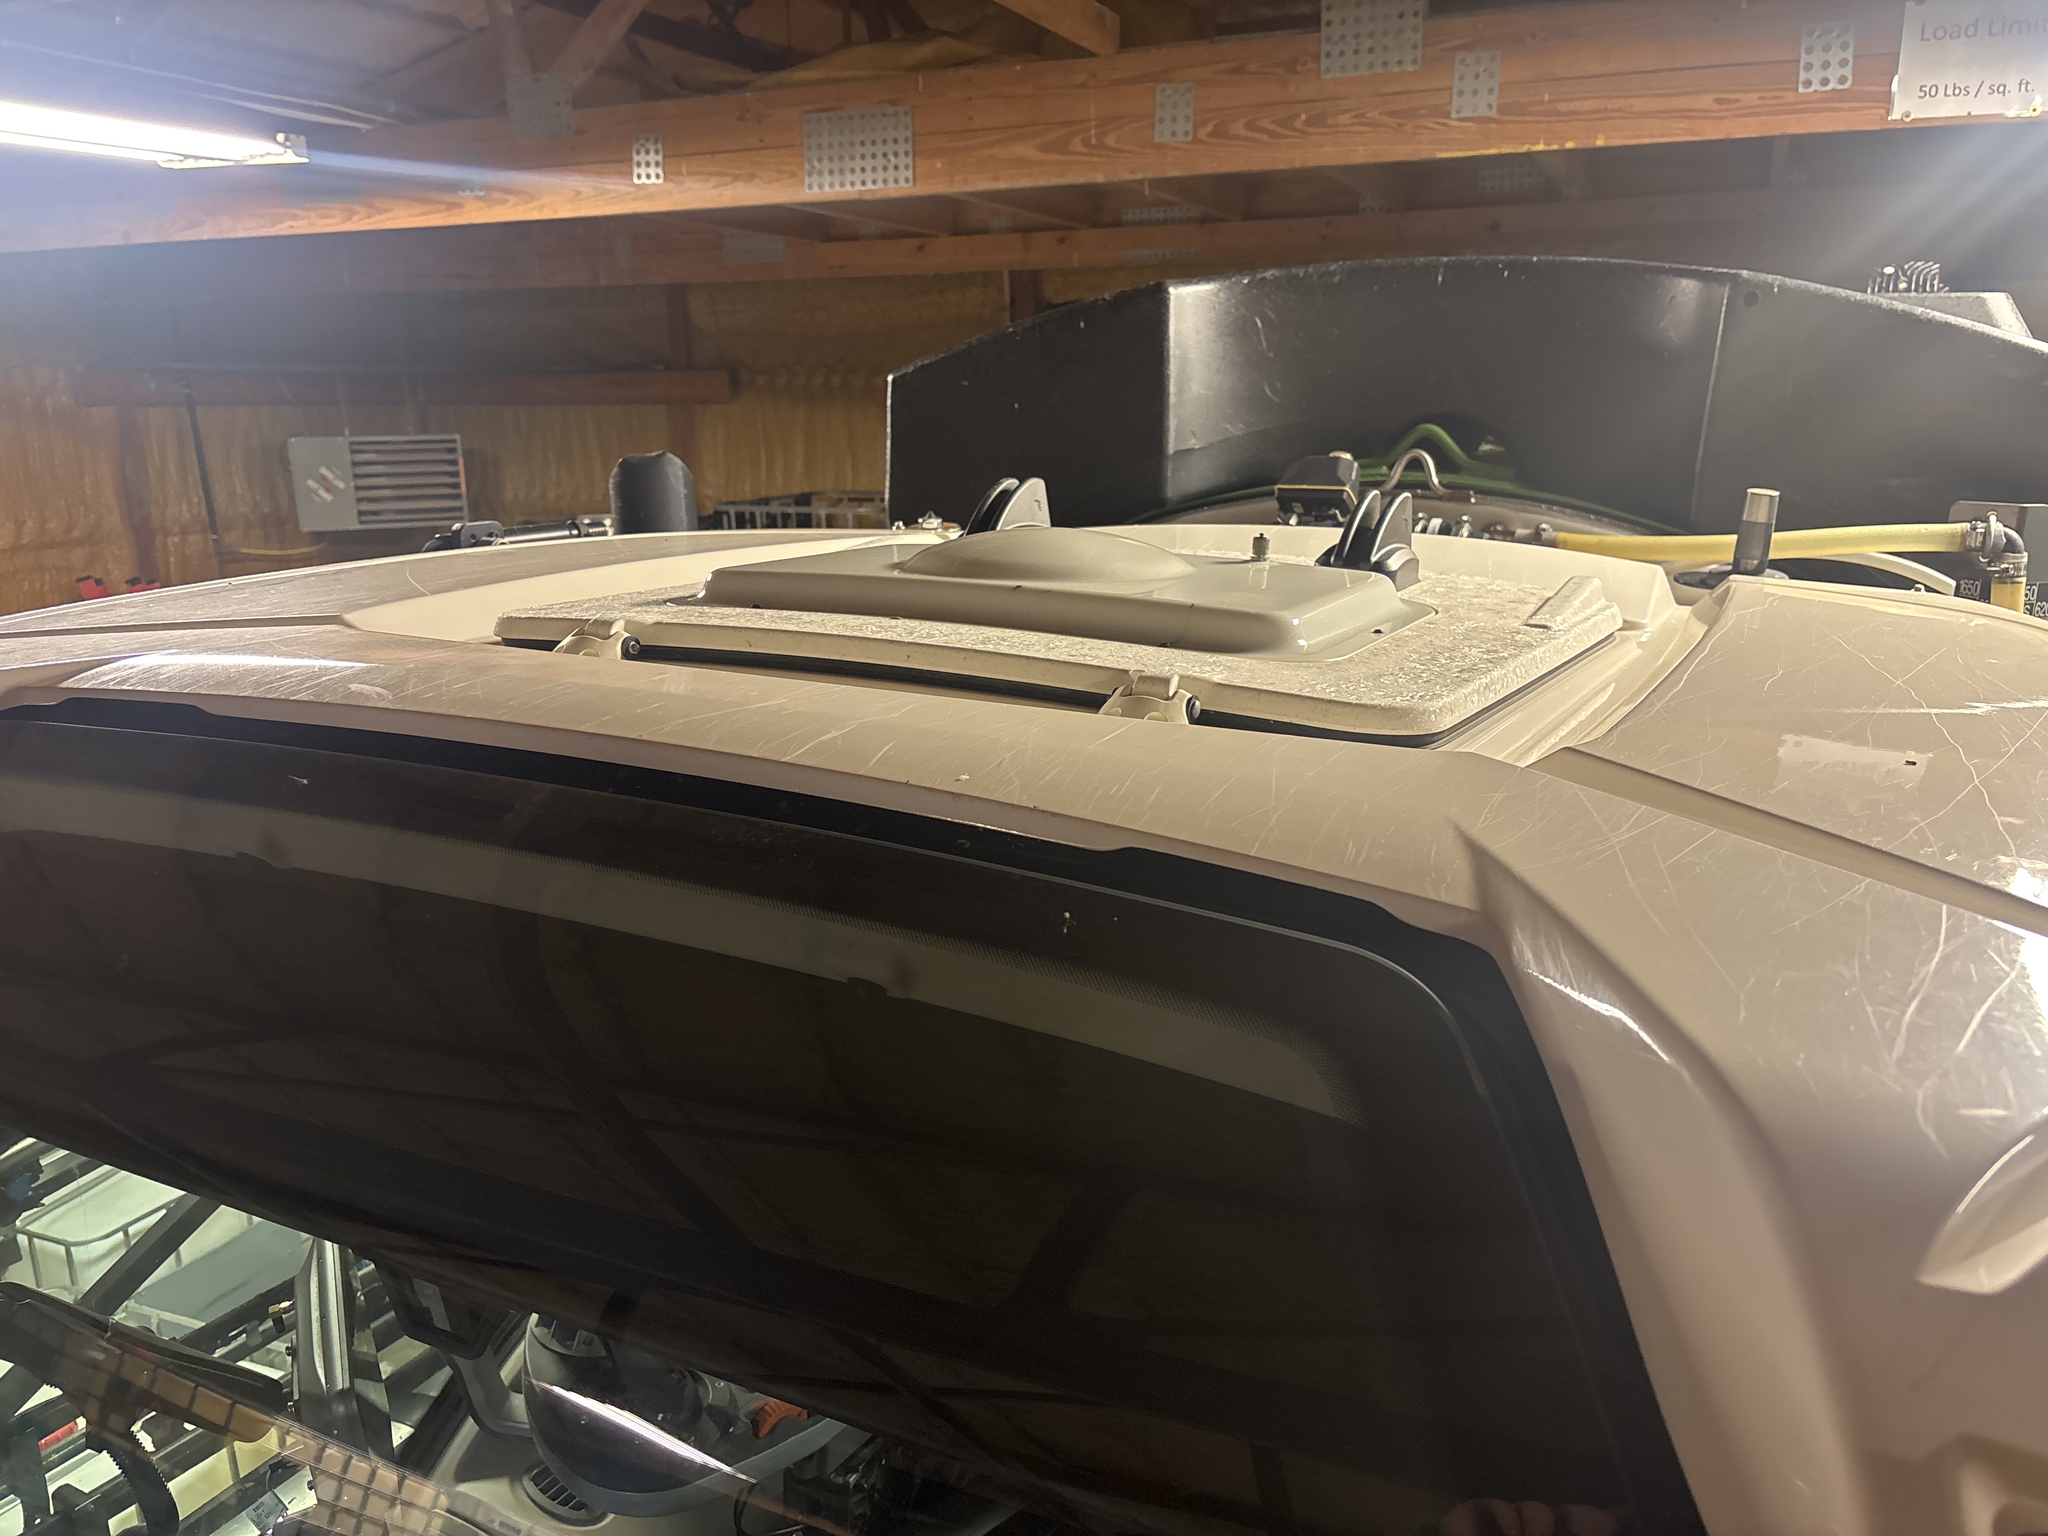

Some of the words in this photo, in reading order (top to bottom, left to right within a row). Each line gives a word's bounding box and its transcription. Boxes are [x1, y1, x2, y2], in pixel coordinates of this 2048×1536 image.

[1920, 17, 1979, 42] Load
[1918, 84, 1939, 99] 50
[1944, 82, 1971, 98] Lbs
[1988, 83, 2011, 98] sq.
[2017, 78, 2035, 94] ft.
